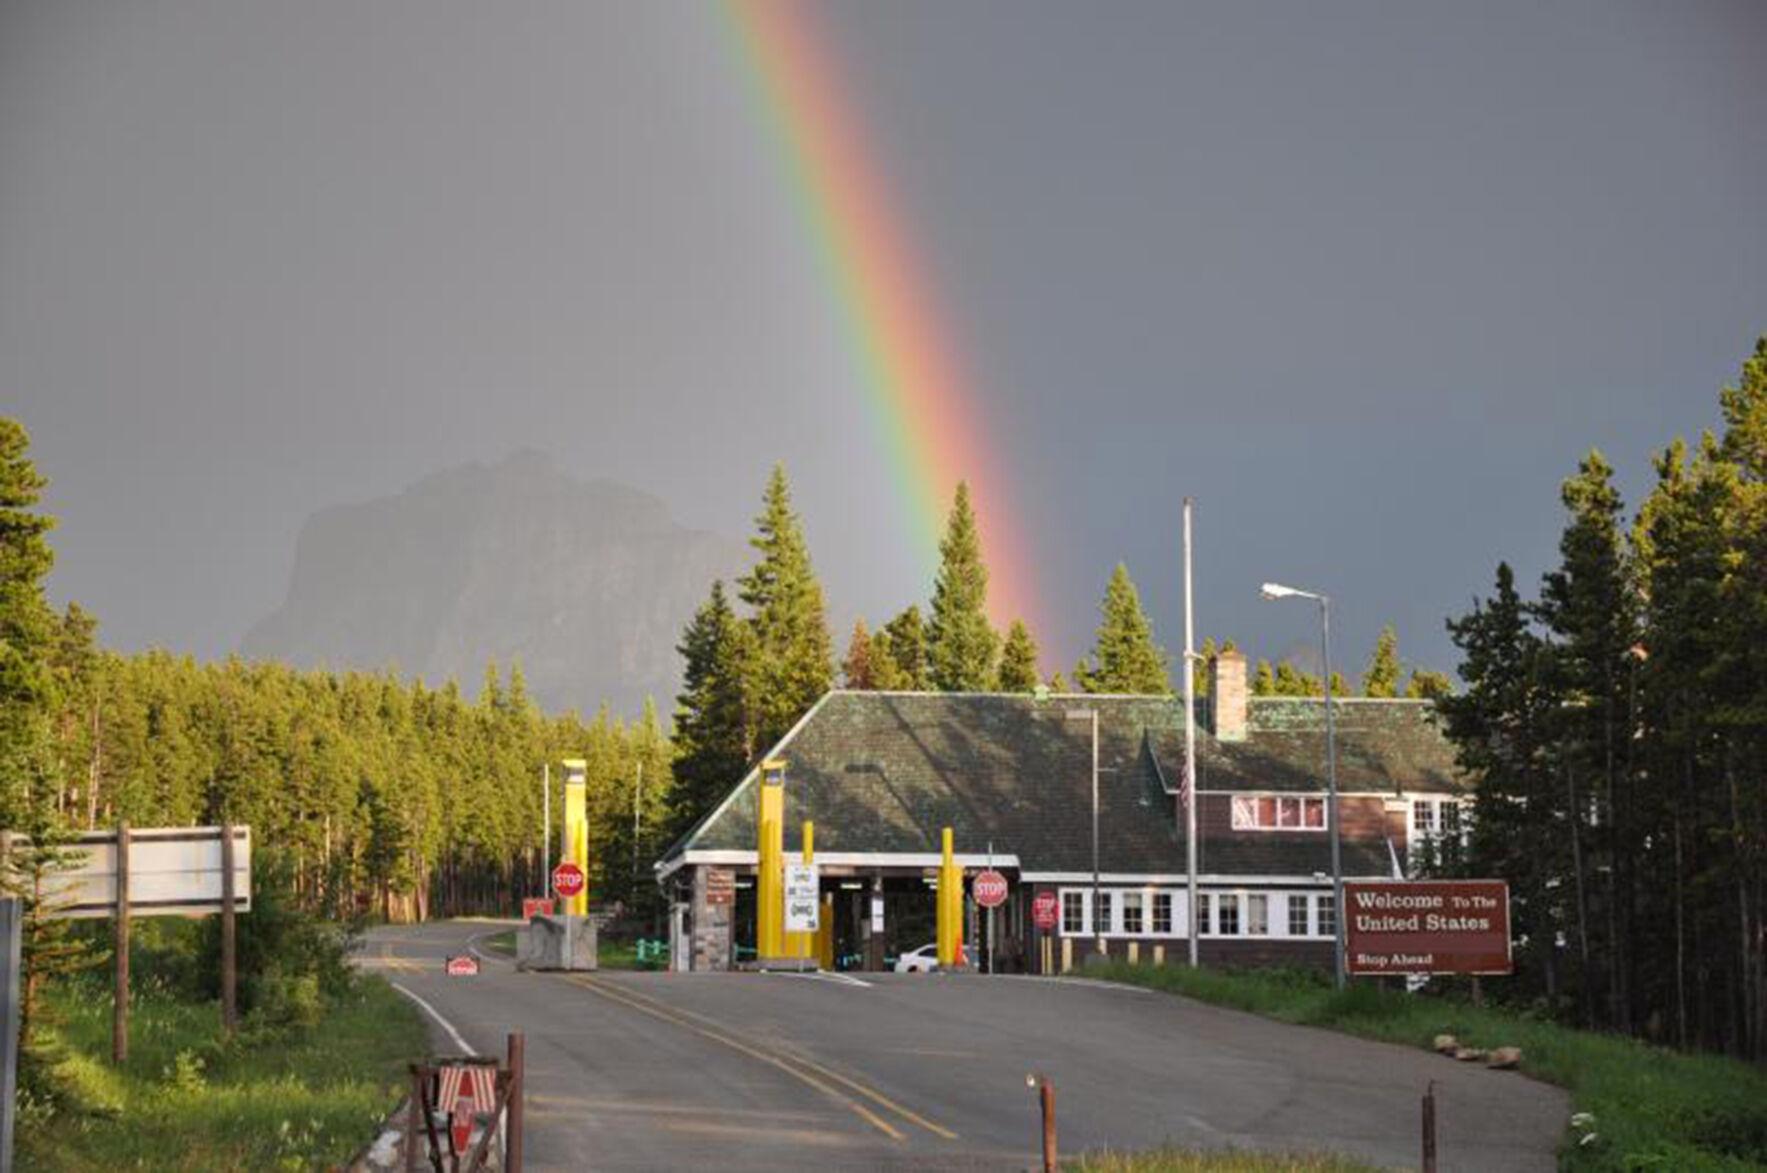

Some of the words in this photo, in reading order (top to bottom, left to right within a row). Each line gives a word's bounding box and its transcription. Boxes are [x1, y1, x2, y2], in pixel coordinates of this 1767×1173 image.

[555, 874, 582, 887] STOP
[977, 881, 1007, 896] STOP
[1356, 892, 1443, 908] Welcome
[1452, 896, 1470, 908] To
[1472, 896, 1497, 908] The
[1356, 914, 1419, 931] United
[1426, 914, 1490, 931] States
[1357, 954, 1388, 967] Stop
[1391, 953, 1433, 965] Ahead
